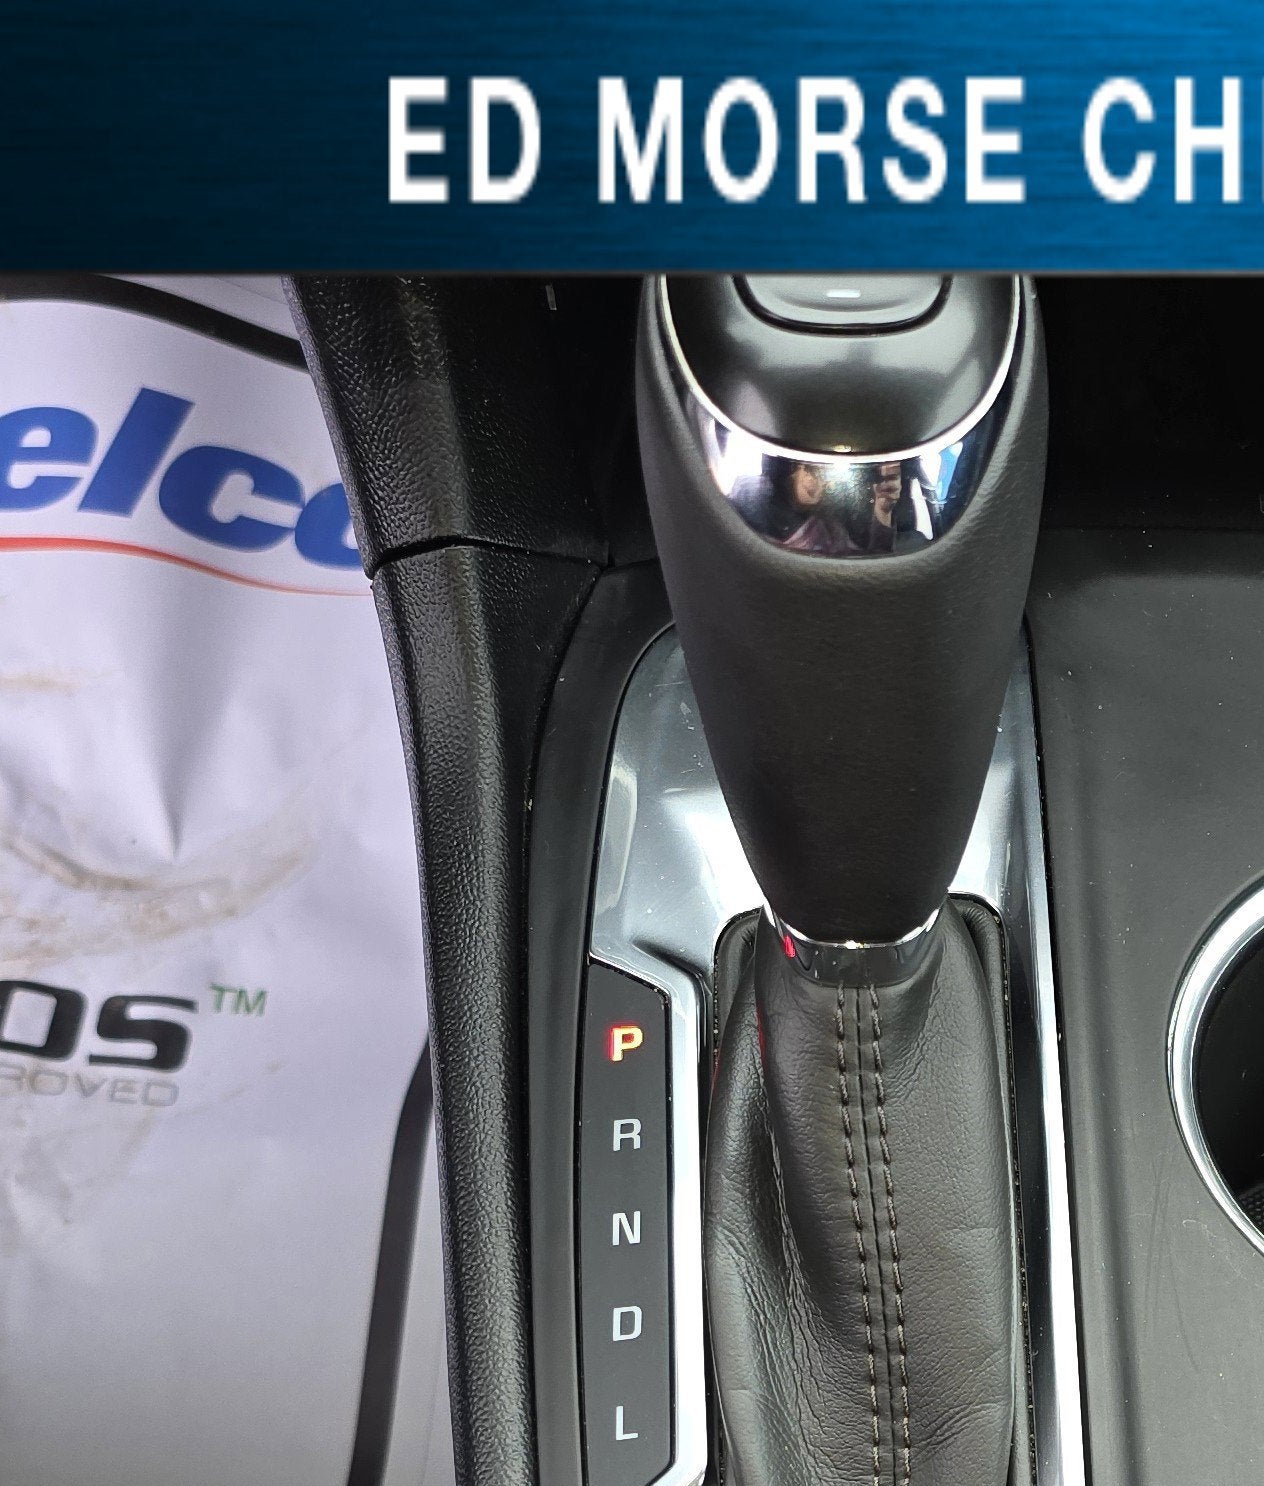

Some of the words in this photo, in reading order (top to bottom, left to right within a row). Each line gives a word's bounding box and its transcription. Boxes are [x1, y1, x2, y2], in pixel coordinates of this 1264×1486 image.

[609, 1025, 644, 1062] P
[612, 1117, 643, 1152] R
[611, 1210, 642, 1246] N
[612, 1305, 643, 1341] D
[614, 1405, 640, 1441] L
